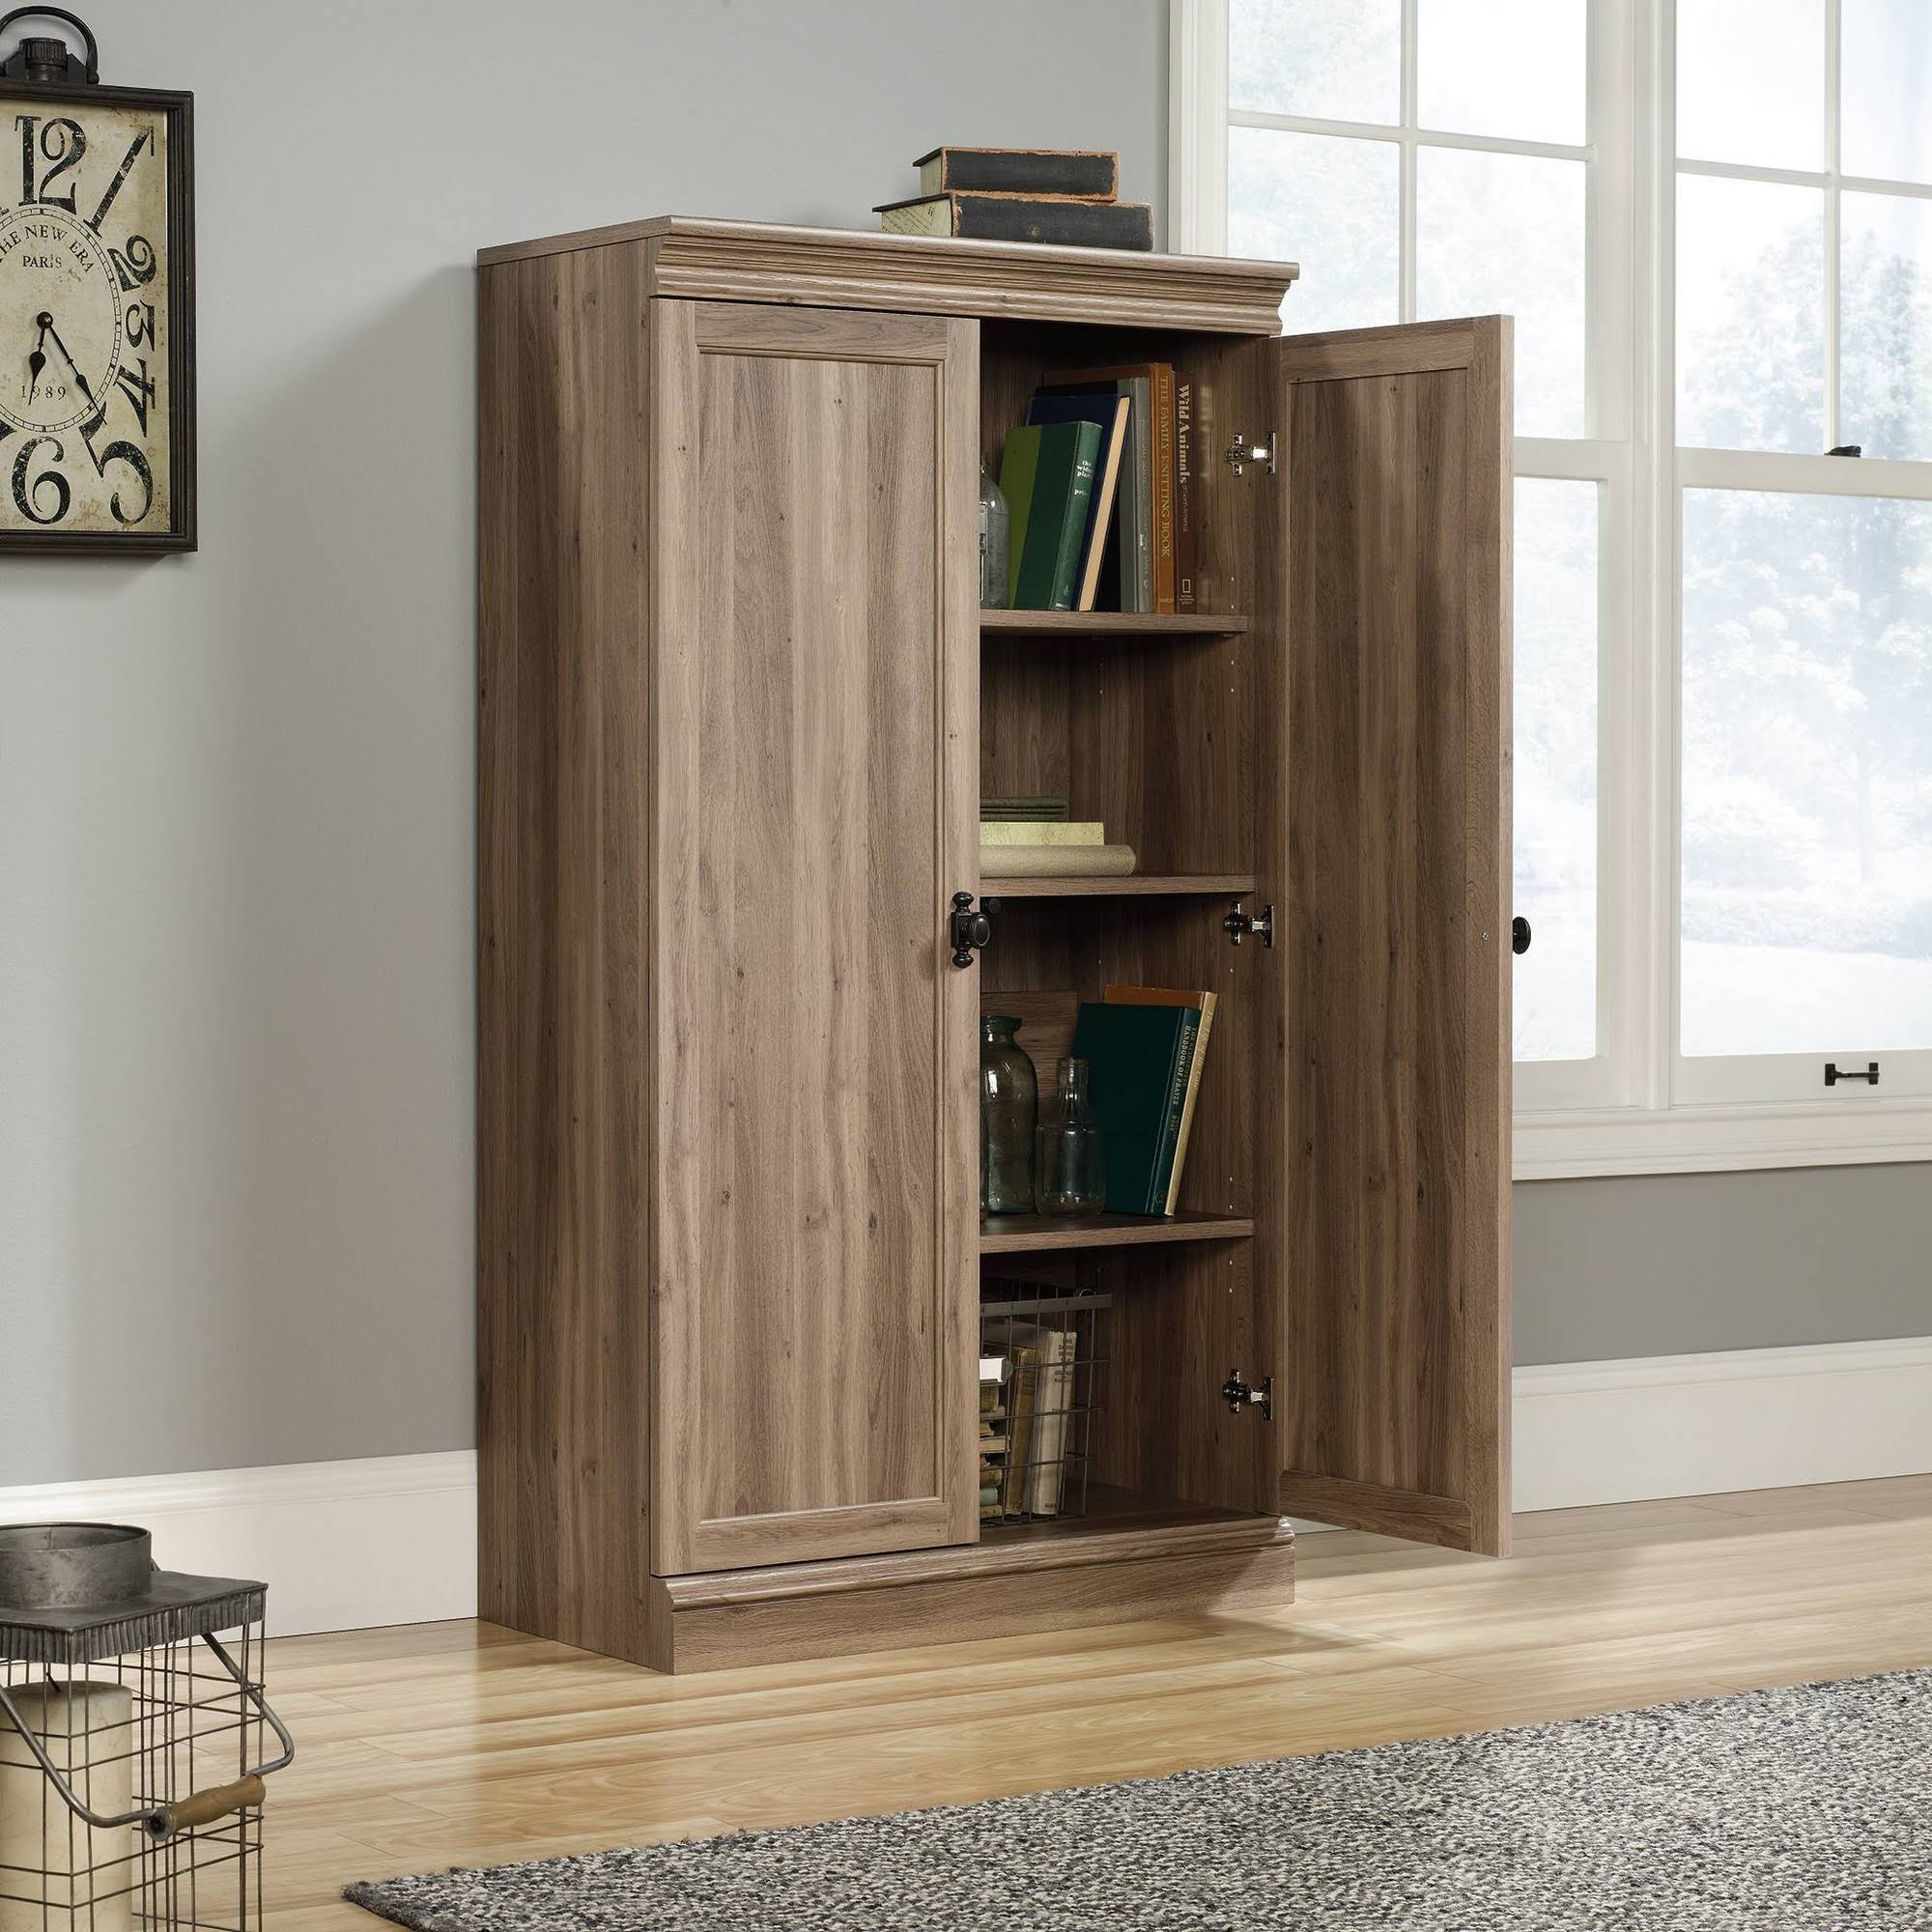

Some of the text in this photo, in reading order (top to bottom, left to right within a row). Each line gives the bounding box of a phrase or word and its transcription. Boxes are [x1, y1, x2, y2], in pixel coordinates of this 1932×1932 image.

[14, 115, 87, 214] 12
[83, 125, 155, 240] 1
[0, 224, 94, 273] HE NEW ERA
[22, 254, 62, 269] PARIS
[106, 235, 156, 293] 2
[126, 299, 155, 352] 3
[21, 385, 67, 400] 1989
[113, 357, 156, 438] 4
[1179, 384, 1189, 418] Wild
[78, 401, 153, 526] 5
[1179, 421, 1190, 483] Animals
[12, 436, 71, 525] 6
[1161, 455, 1170, 517] KNITTING
[1161, 522, 1170, 557] BOOK
[1179, 1025, 1192, 1066] HANDBOOK
[1173, 1078, 1181, 1105] PRAYER
